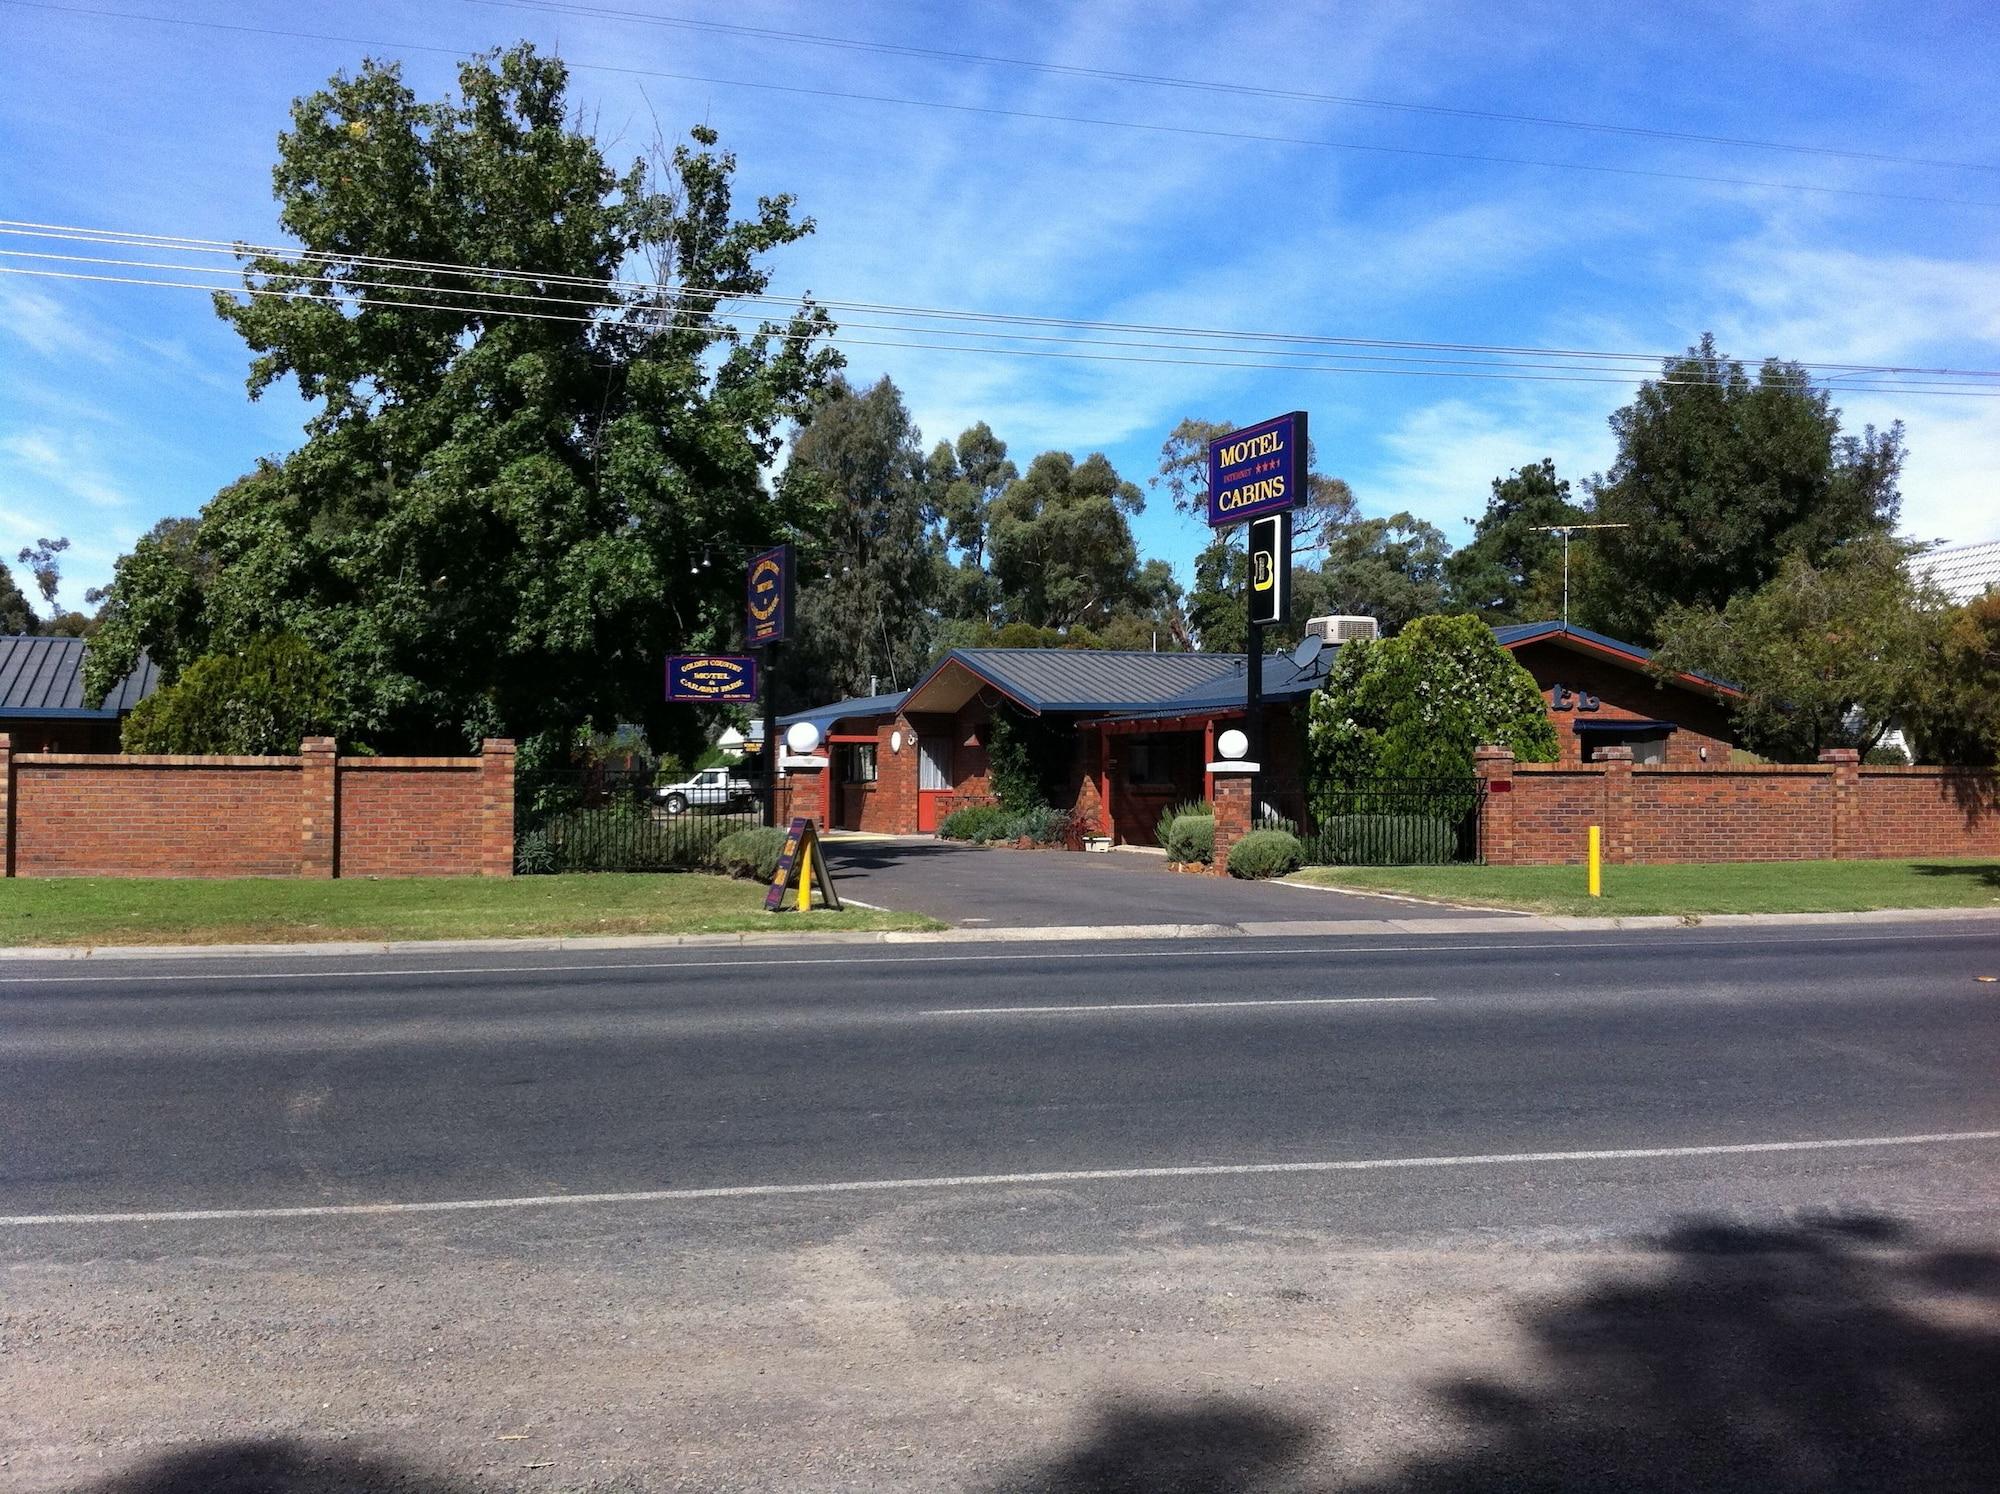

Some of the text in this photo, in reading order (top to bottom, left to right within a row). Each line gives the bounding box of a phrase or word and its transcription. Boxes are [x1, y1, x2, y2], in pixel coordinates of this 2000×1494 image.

[1220, 431, 1284, 468] MOTEL
[1219, 475, 1285, 511] CABINS
[681, 659, 743, 673] GOLDEN COUNTRY
[694, 672, 730, 680] MOTEL
[680, 678, 744, 694] CARAVAN PARK
